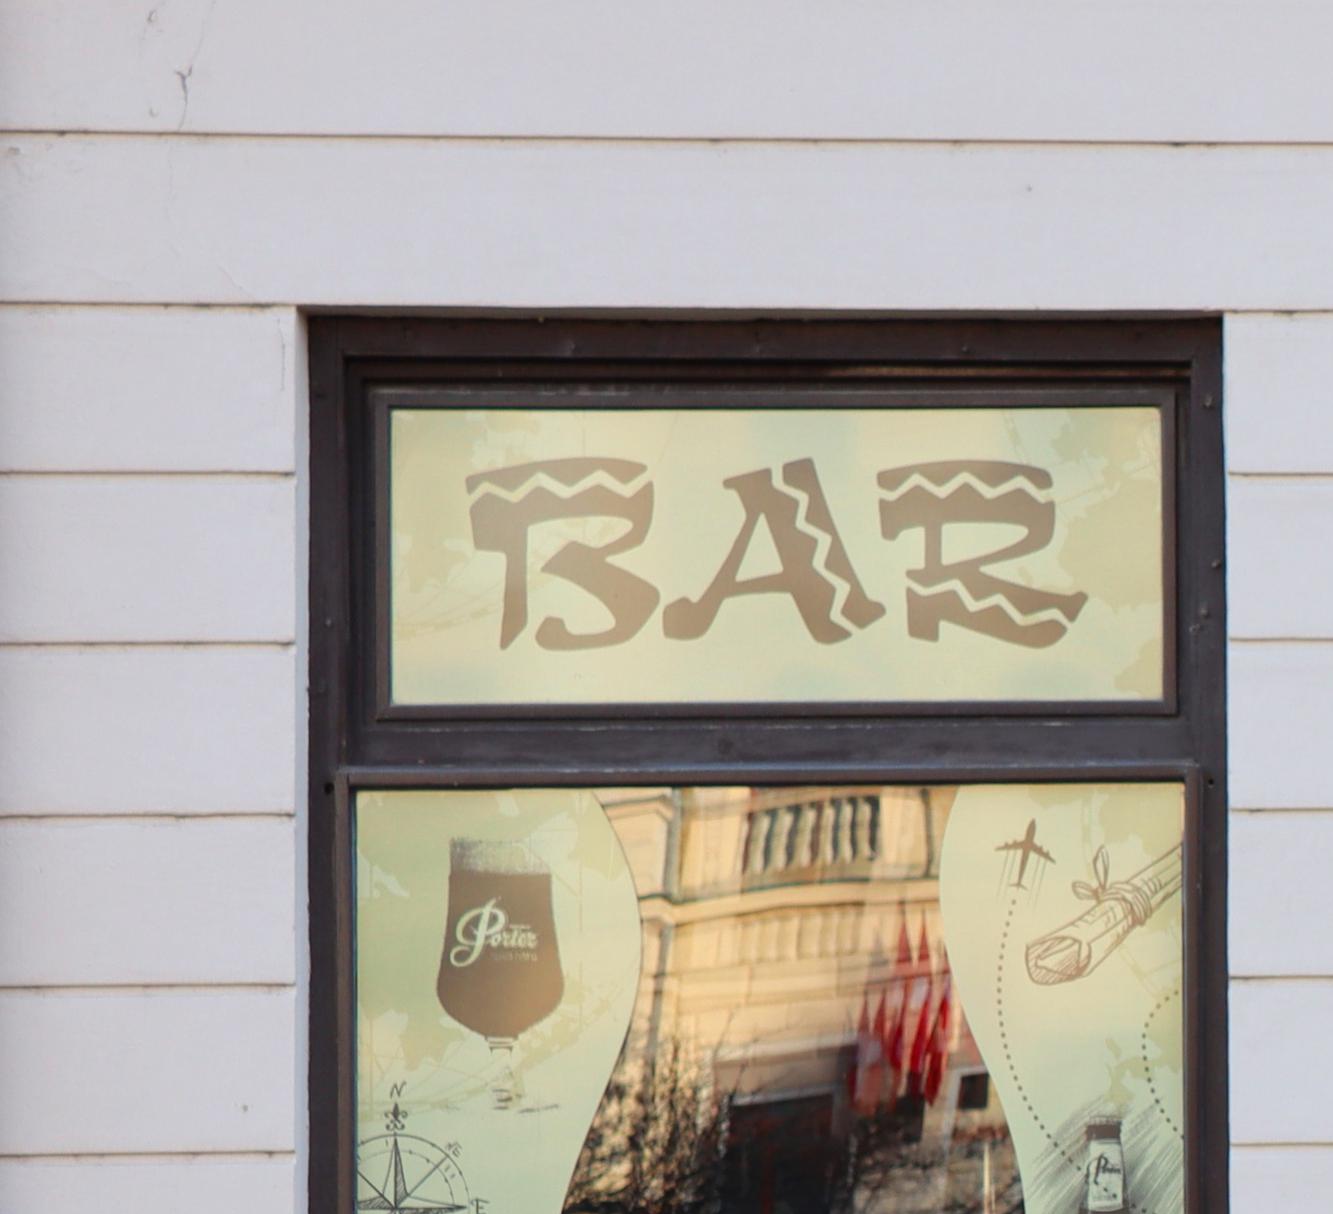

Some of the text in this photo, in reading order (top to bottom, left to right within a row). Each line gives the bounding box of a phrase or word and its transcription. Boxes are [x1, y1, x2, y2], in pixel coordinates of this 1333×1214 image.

[465, 456, 1089, 651] BAR
[450, 897, 538, 967] Porter
[390, 1081, 407, 1098] N
